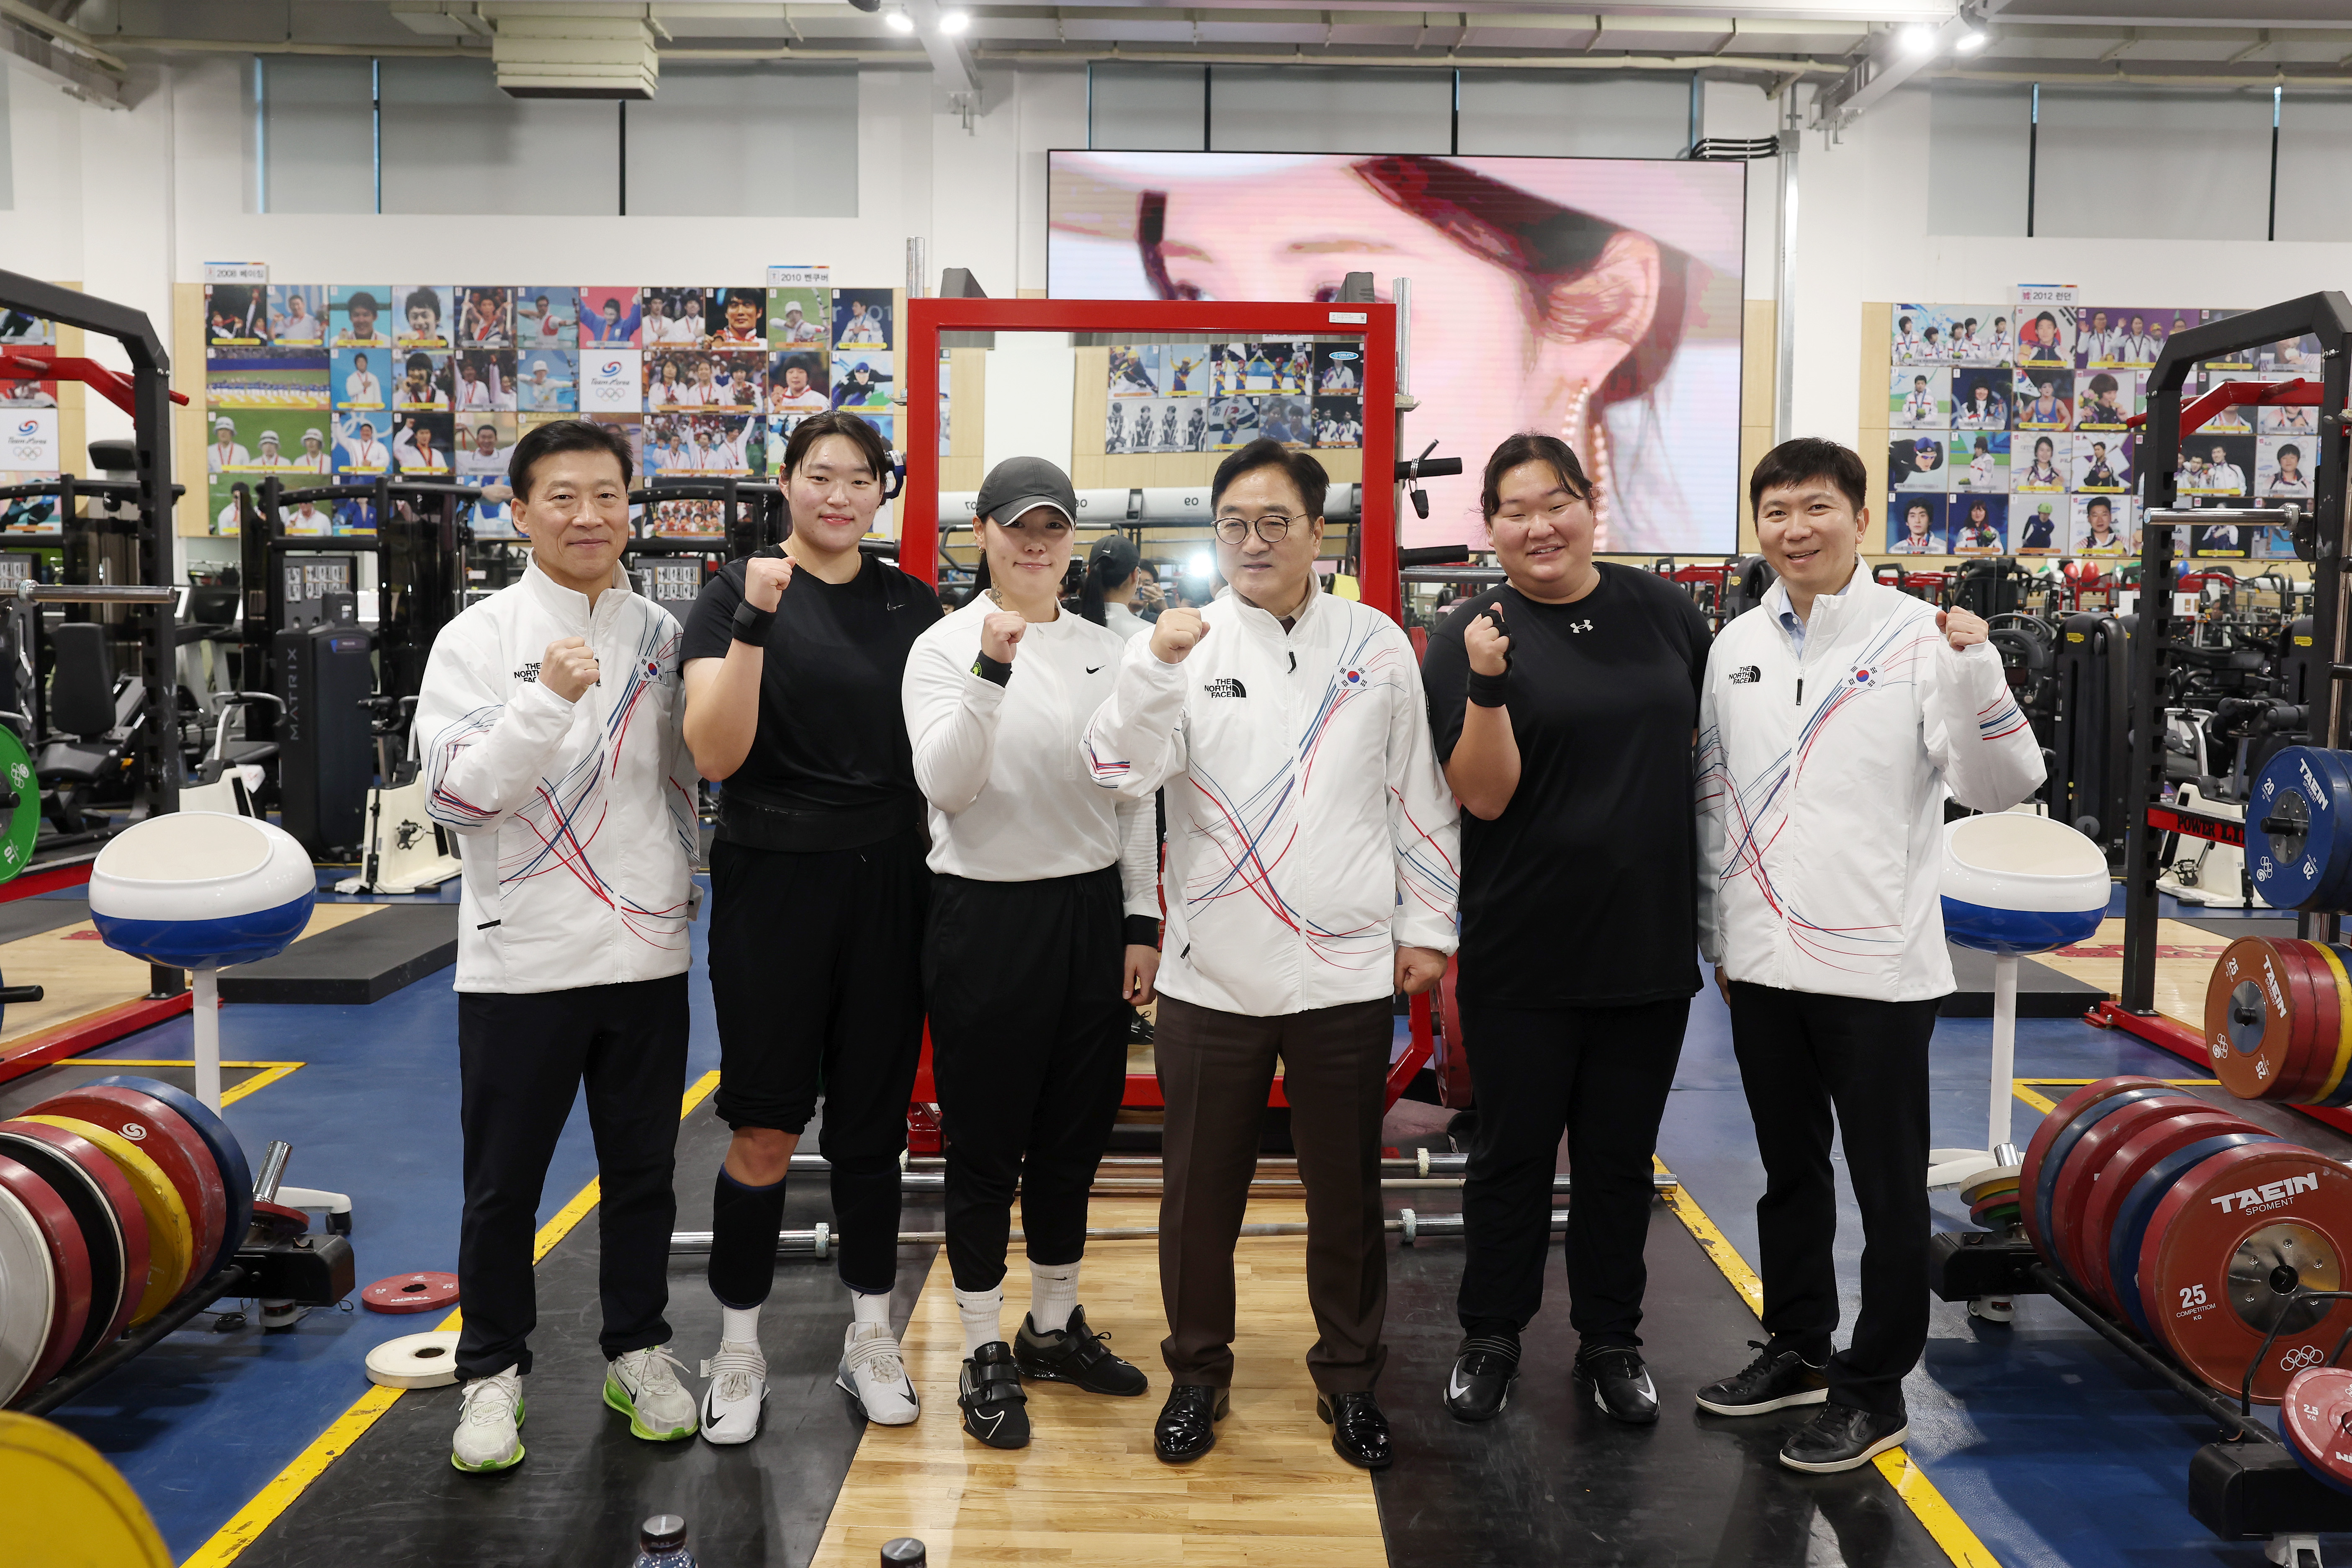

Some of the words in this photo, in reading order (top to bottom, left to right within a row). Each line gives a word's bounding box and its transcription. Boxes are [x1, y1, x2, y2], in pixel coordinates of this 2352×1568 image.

[2056, 292, 2071, 301] 런던
[1728, 672, 1750, 680] NORTH
[2264, 778, 2275, 795] 20
[2299, 757, 2329, 811] TAEIN
[2303, 780, 2317, 803] SPOMENT
[2178, 815, 2216, 837] POWER
[4, 846, 15, 865] 10
[2303, 861, 2314, 880] 20
[2228, 957, 2239, 975] 25
[2263, 954, 2287, 1018] TAEIN
[2265, 978, 2276, 1006] SPOMENT
[2255, 1061, 2266, 1080] 25
[2210, 1172, 2319, 1214] TAEIN
[2245, 1196, 2295, 1215] SPOMENT
[2179, 1283, 2207, 1309] 25
[2303, 1404, 2319, 1416] 2.5
